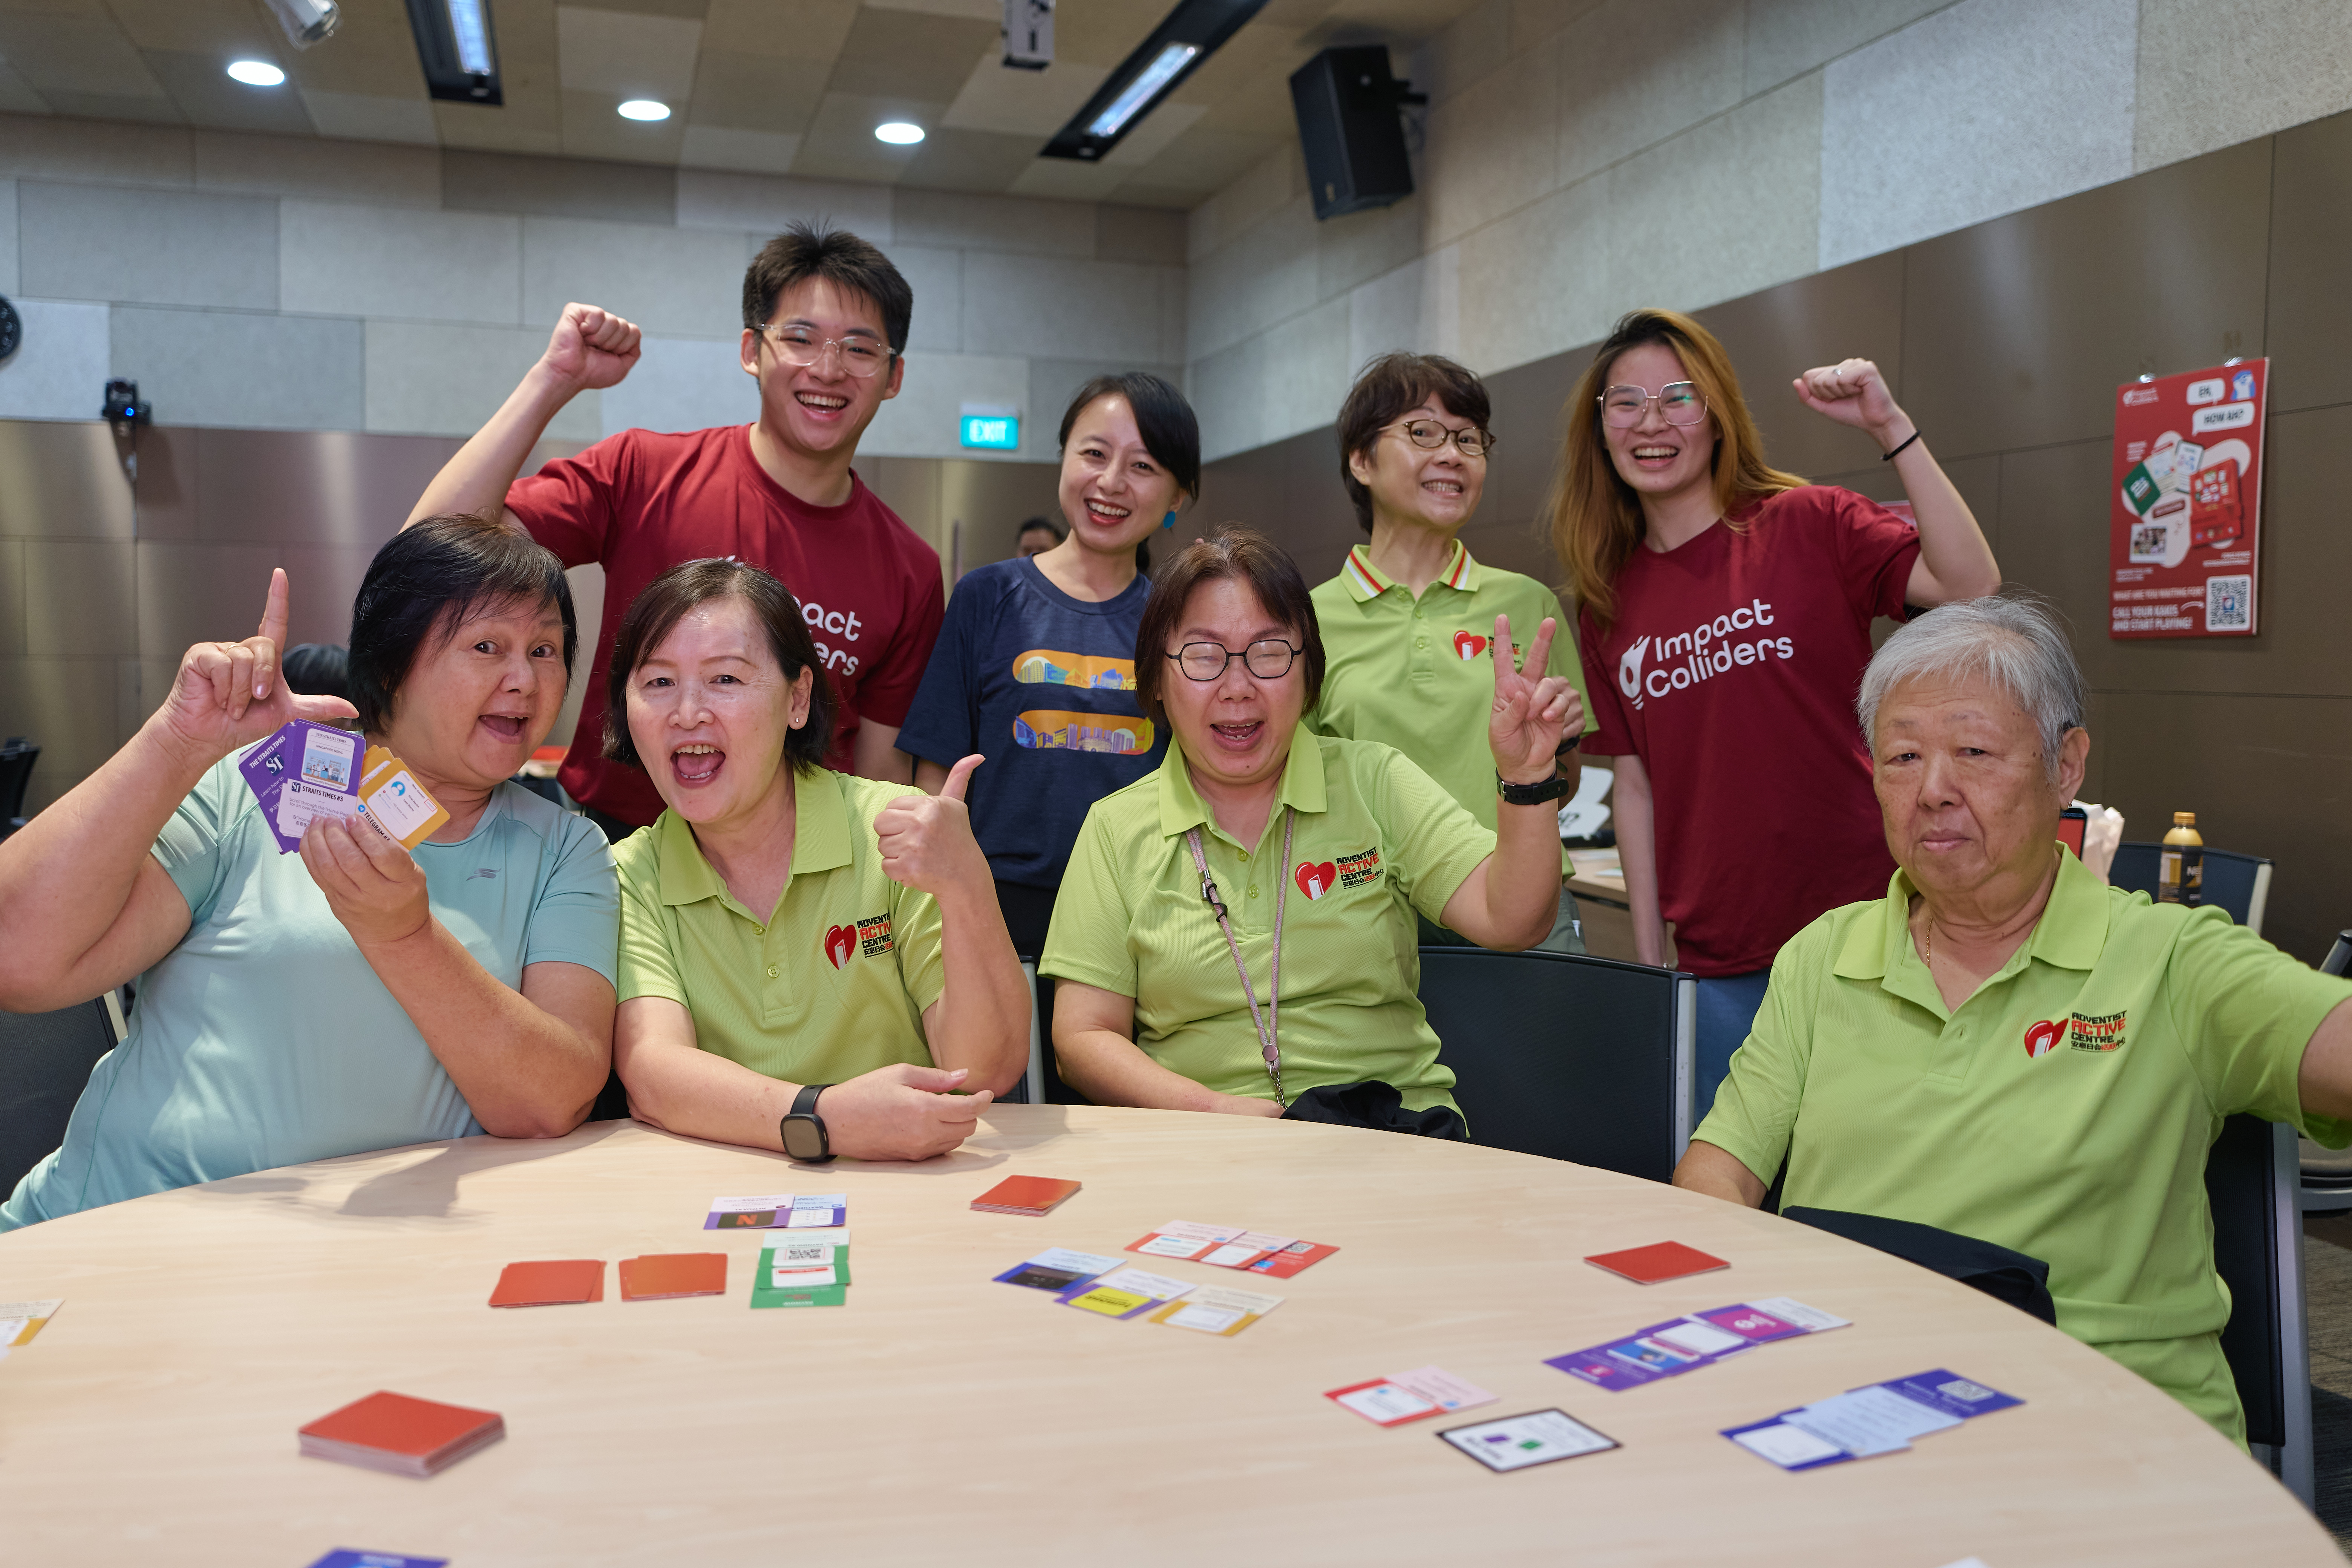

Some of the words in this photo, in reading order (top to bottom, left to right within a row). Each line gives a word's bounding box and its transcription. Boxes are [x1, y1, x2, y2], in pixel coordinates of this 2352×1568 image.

[2204, 412, 2224, 425] HOW
[969, 420, 1007, 442] EXIT
[2131, 605, 2153, 617] YOUR
[1655, 598, 1774, 662] Impact
[2112, 619, 2130, 632] AND
[2130, 618, 2154, 631] START
[1646, 637, 1794, 697] Colliders
[249, 760, 259, 769] THE
[259, 746, 274, 761] STRAITS
[273, 735, 286, 749] TIMES
[265, 754, 284, 773] ST
[260, 787, 271, 797] Learn
[271, 779, 280, 789] how
[292, 782, 301, 792] ST
[302, 786, 322, 796] STRAITS
[322, 791, 337, 800] TIMES
[416, 789, 425, 799] Contact
[302, 800, 317, 808] through
[364, 812, 384, 836] TELEGRAM
[1336, 846, 1377, 864] ADVENTIST
[1338, 853, 1379, 874] ACTIVE
[1341, 868, 1372, 881] CENTRE
[862, 934, 891, 948] CENTRE
[2072, 1010, 2127, 1024] ADVENTIST
[2072, 1017, 2126, 1037] ACTIVE
[2071, 1032, 2114, 1043] CENTRE
